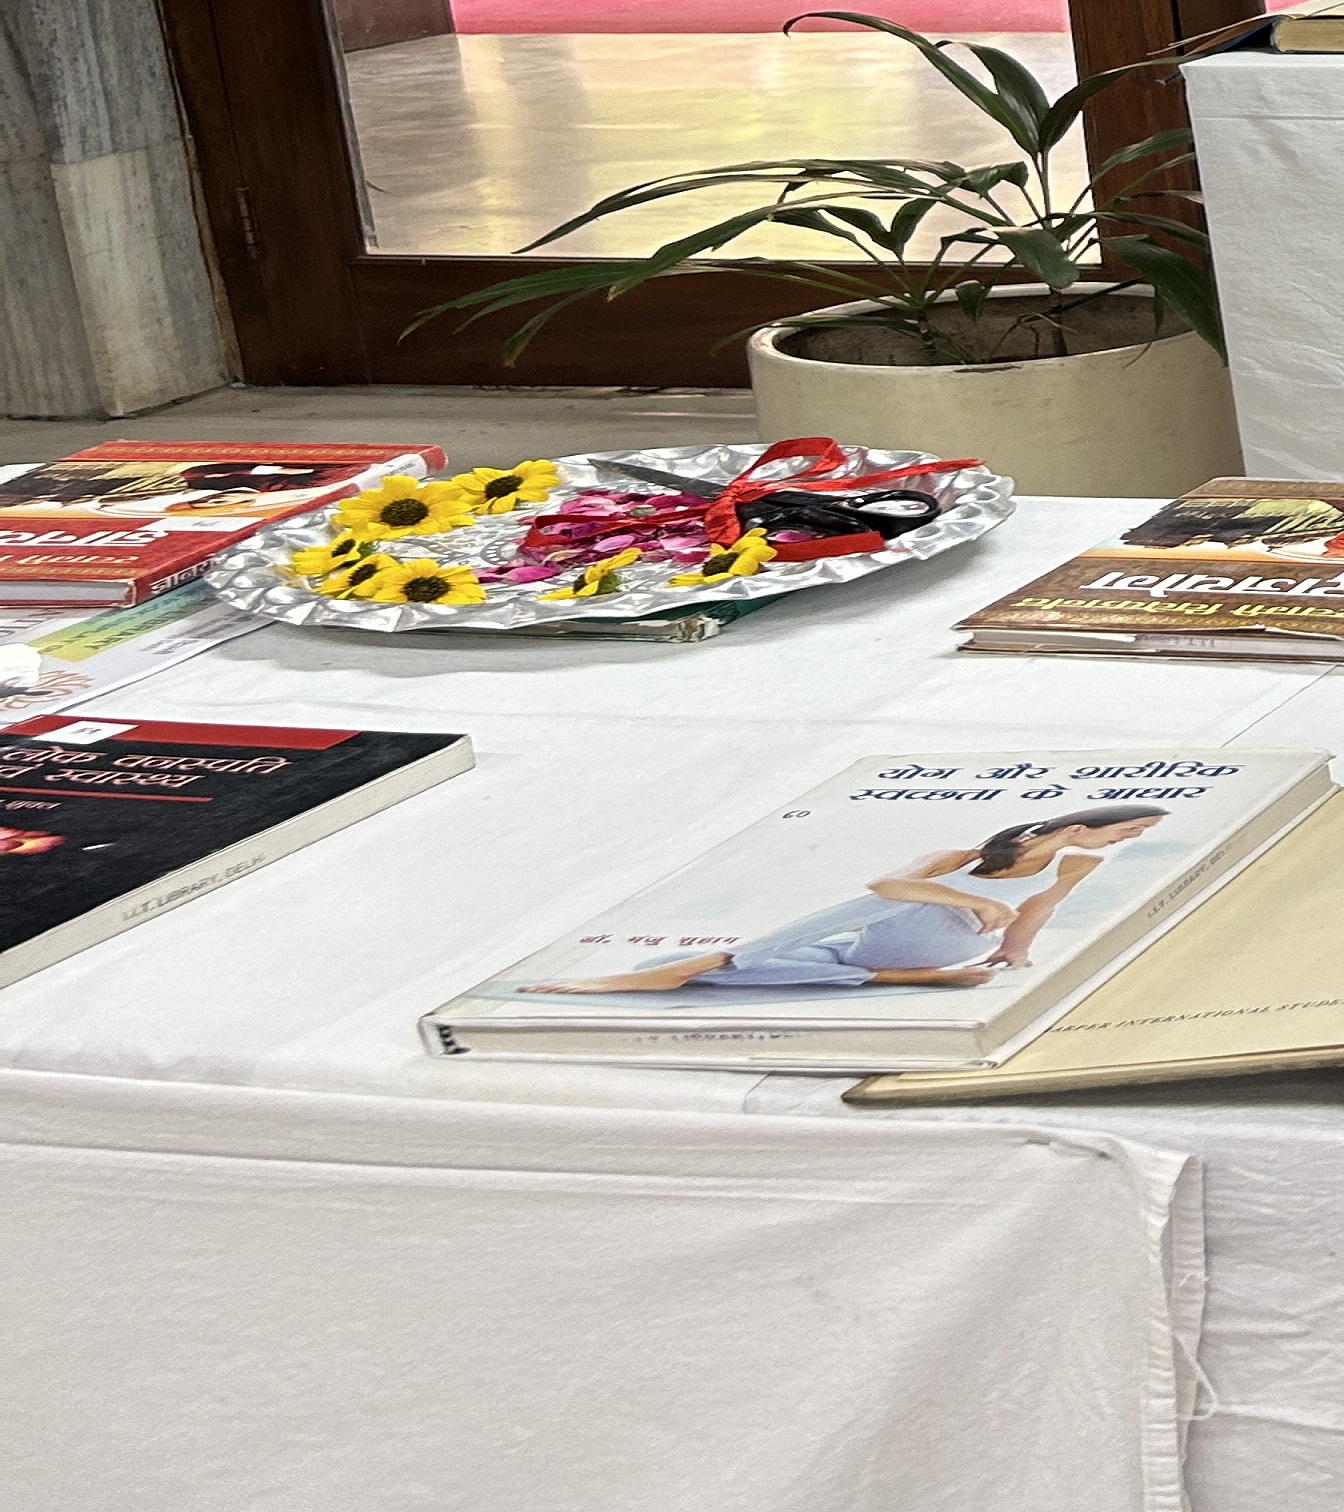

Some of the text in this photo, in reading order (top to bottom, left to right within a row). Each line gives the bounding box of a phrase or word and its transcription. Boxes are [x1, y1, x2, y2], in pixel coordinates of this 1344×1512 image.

[3, 745, 293, 776] लोक वनस्पति
[878, 760, 1248, 781] योग और शारीरिक
[44, 768, 206, 788] स्वास्थ्य
[849, 783, 1215, 803] स्वच्छता के आधार
[782, 808, 813, 820] 60
[1115, 1005, 1271, 1029] INTERNATIONAL
